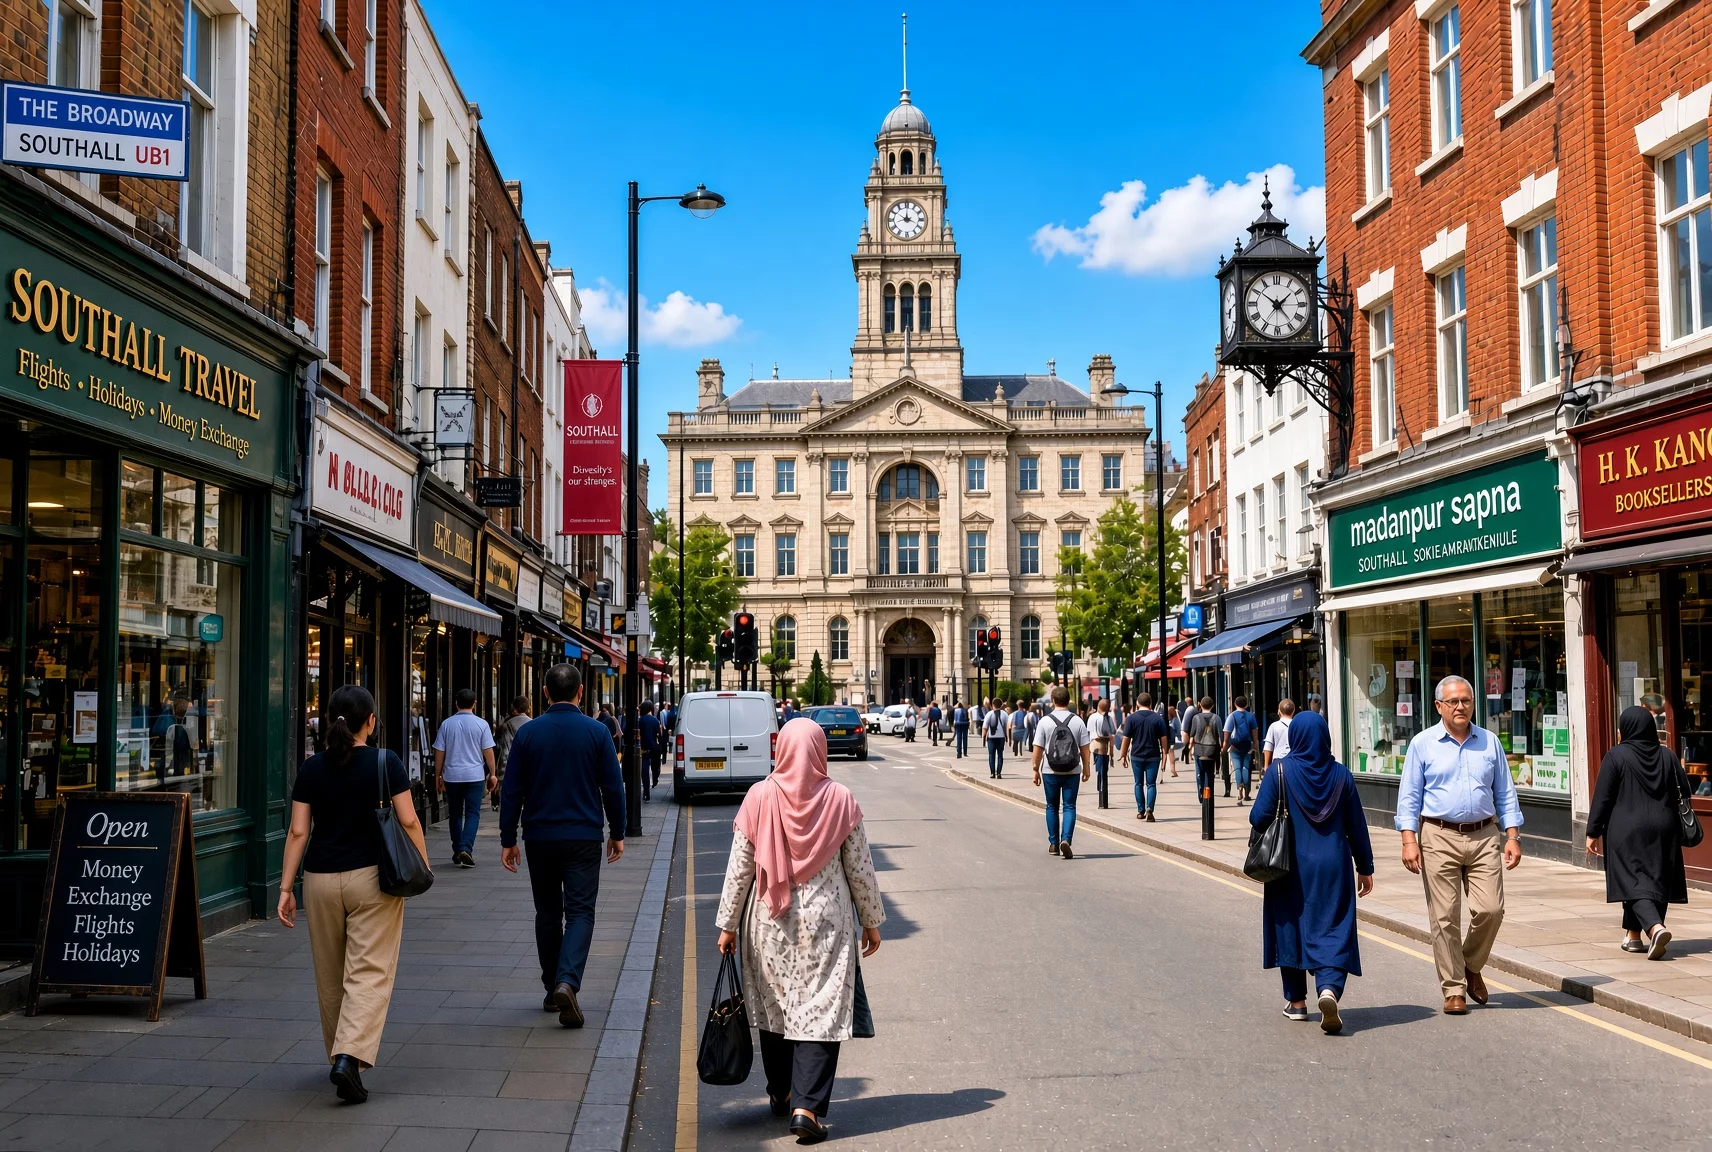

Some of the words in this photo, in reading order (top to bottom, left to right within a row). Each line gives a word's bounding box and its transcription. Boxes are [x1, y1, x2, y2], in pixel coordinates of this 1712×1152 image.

[19, 97, 58, 120] THE
[67, 102, 173, 131] BROADWAY
[19, 133, 126, 162] SOUTHALL
[135, 145, 170, 166] UB1
[11, 267, 171, 383] SOUTHALL
[179, 345, 261, 420] TRAVEL
[18, 348, 70, 391] Flights
[88, 375, 145, 420] Holidays
[158, 401, 198, 442] Money
[200, 418, 250, 460] Exchange
[566, 425, 619, 437] SOUTHALL
[1598, 451, 1620, 485] H.
[1625, 445, 1648, 479] K.
[568, 478, 581, 486] our
[1615, 475, 1712, 513] BOOKSELLERS
[1350, 499, 1444, 547] madanpur
[1450, 481, 1522, 529] sapna
[1358, 549, 1408, 573] SOUTHALL
[86, 812, 149, 845] Open
[81, 859, 144, 884] Money
[66, 886, 152, 911] Exchange
[73, 914, 135, 939] Flights
[62, 942, 140, 968] Holidays
